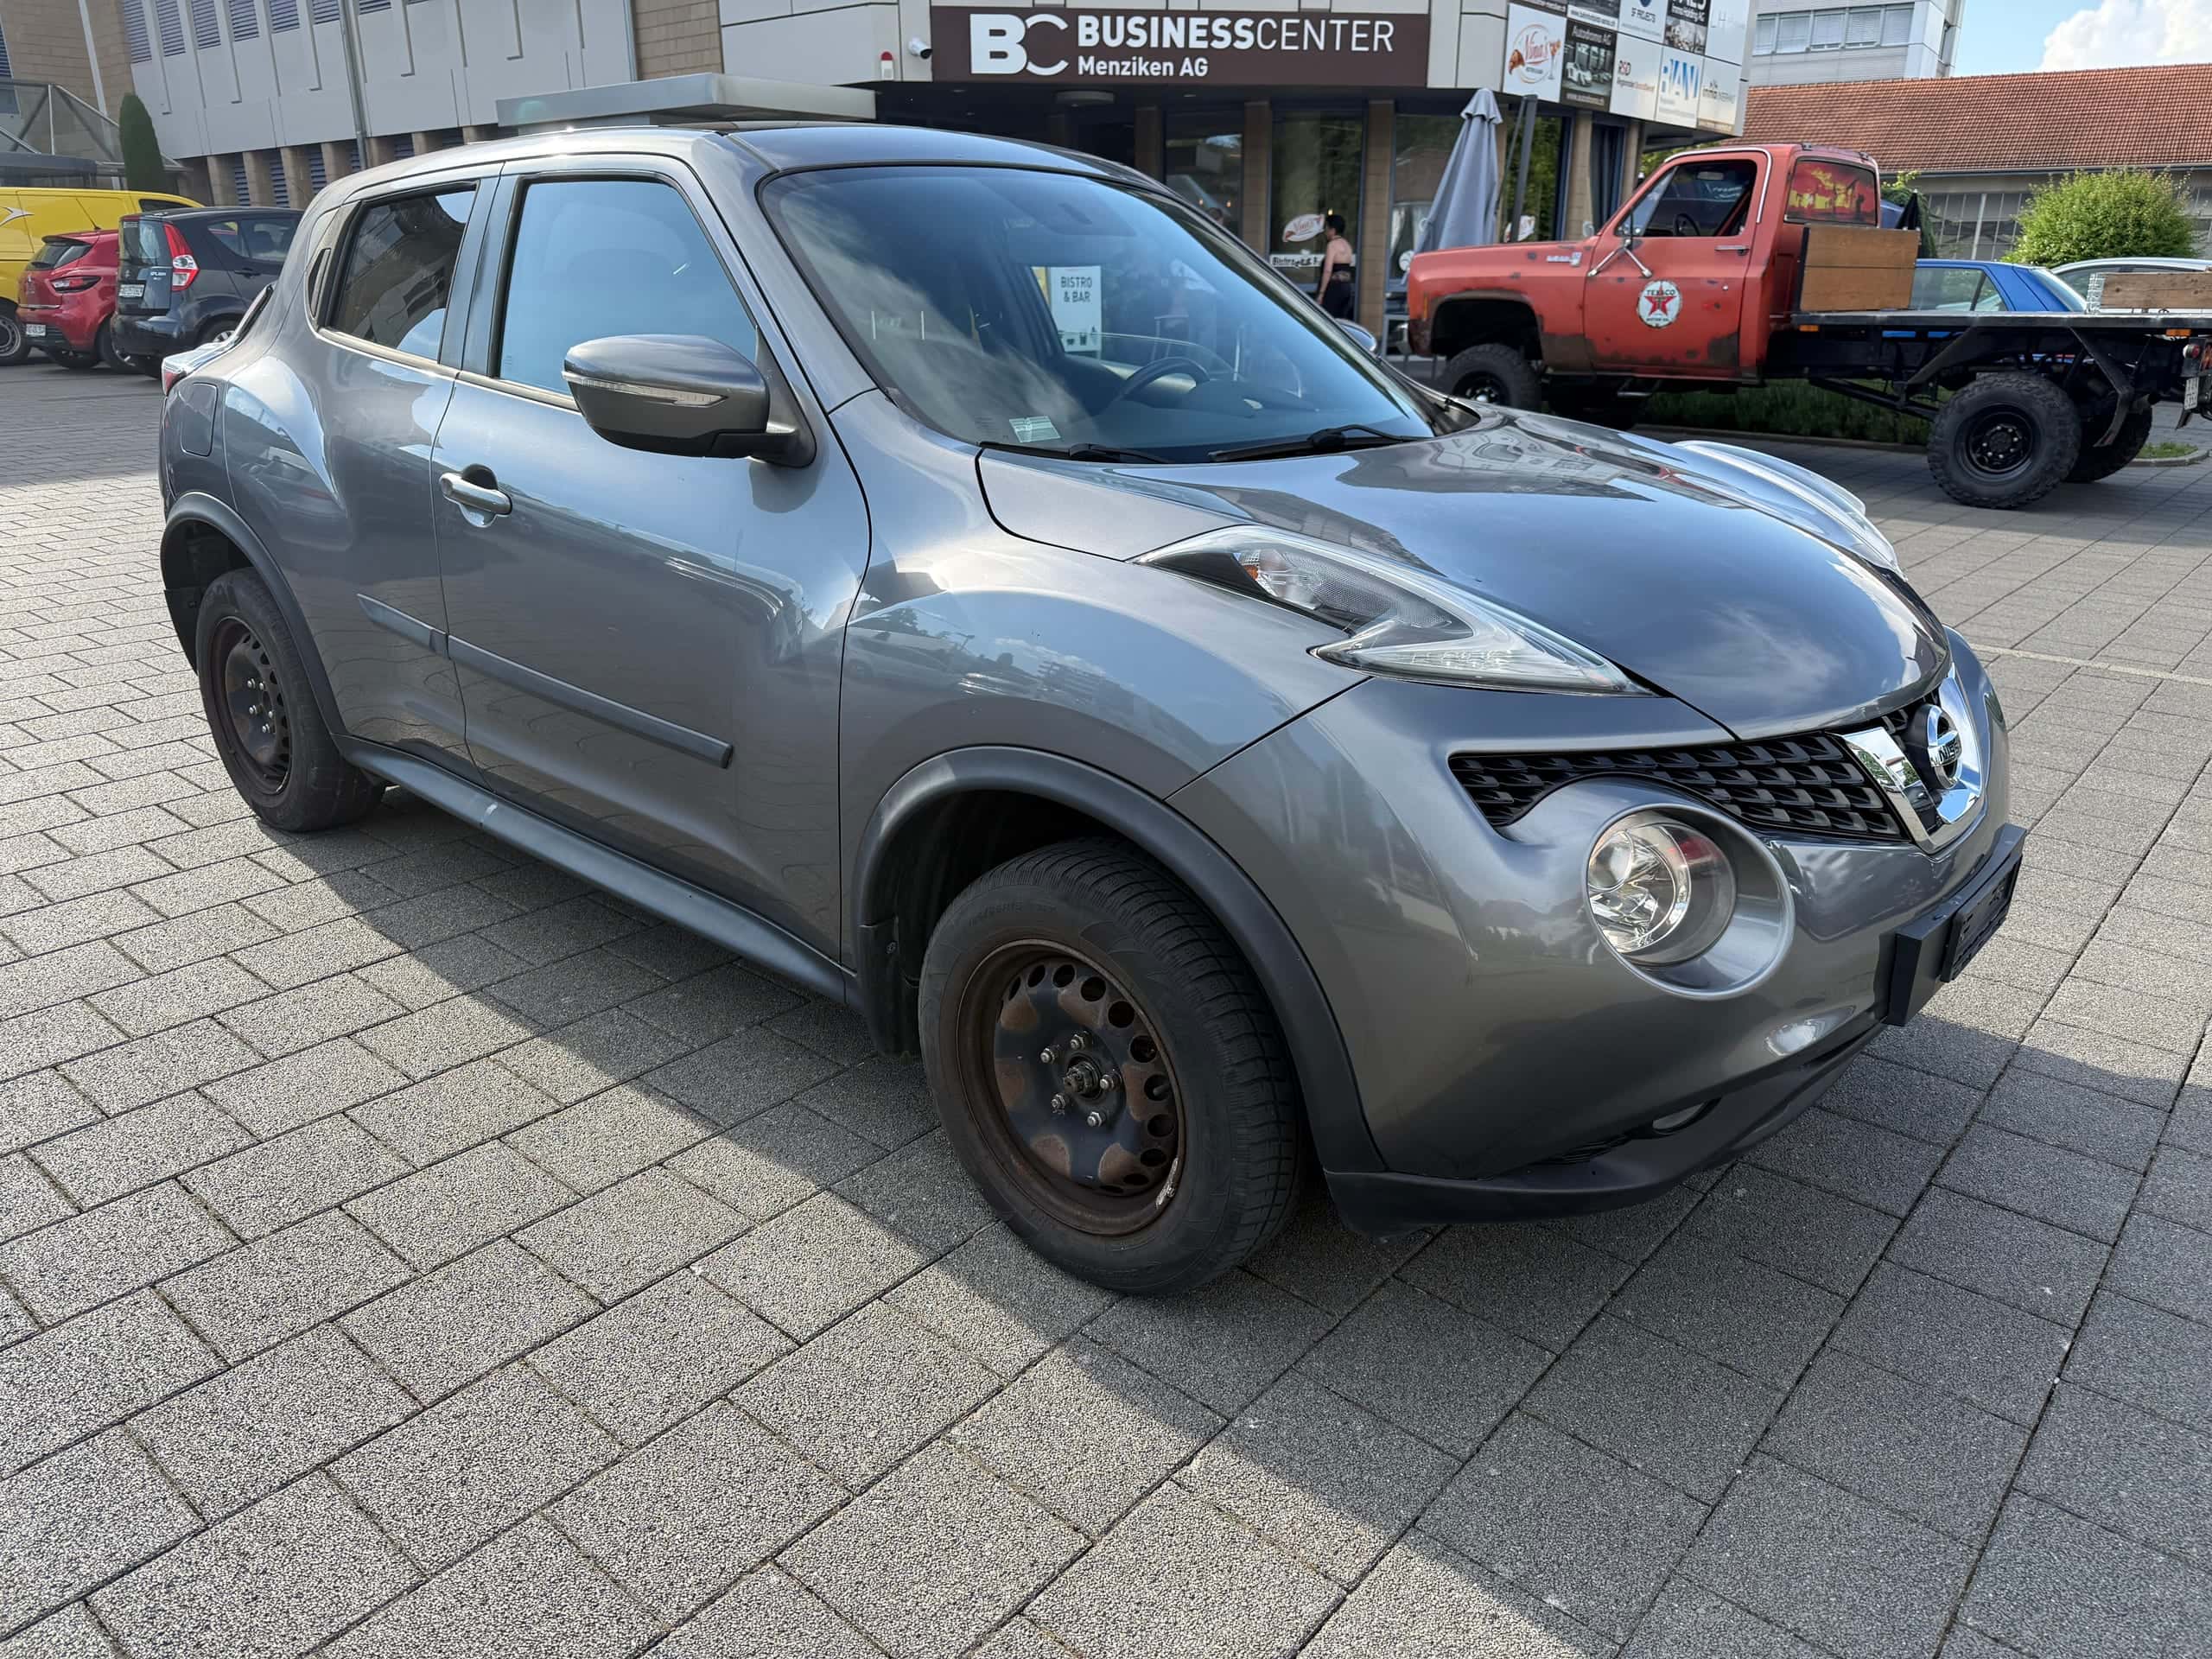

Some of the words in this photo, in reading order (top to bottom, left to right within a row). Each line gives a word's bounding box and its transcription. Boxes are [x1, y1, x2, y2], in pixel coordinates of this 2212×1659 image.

[969, 13, 1069, 76] BC
[1077, 15, 1395, 52] BUSINESSCENTER
[1077, 55, 1173, 77] Menziken
[1179, 57, 1209, 77] AG
[1060, 276, 1092, 288] BISTRO
[1064, 291, 1070, 302] &
[1072, 291, 1091, 302] BAR
